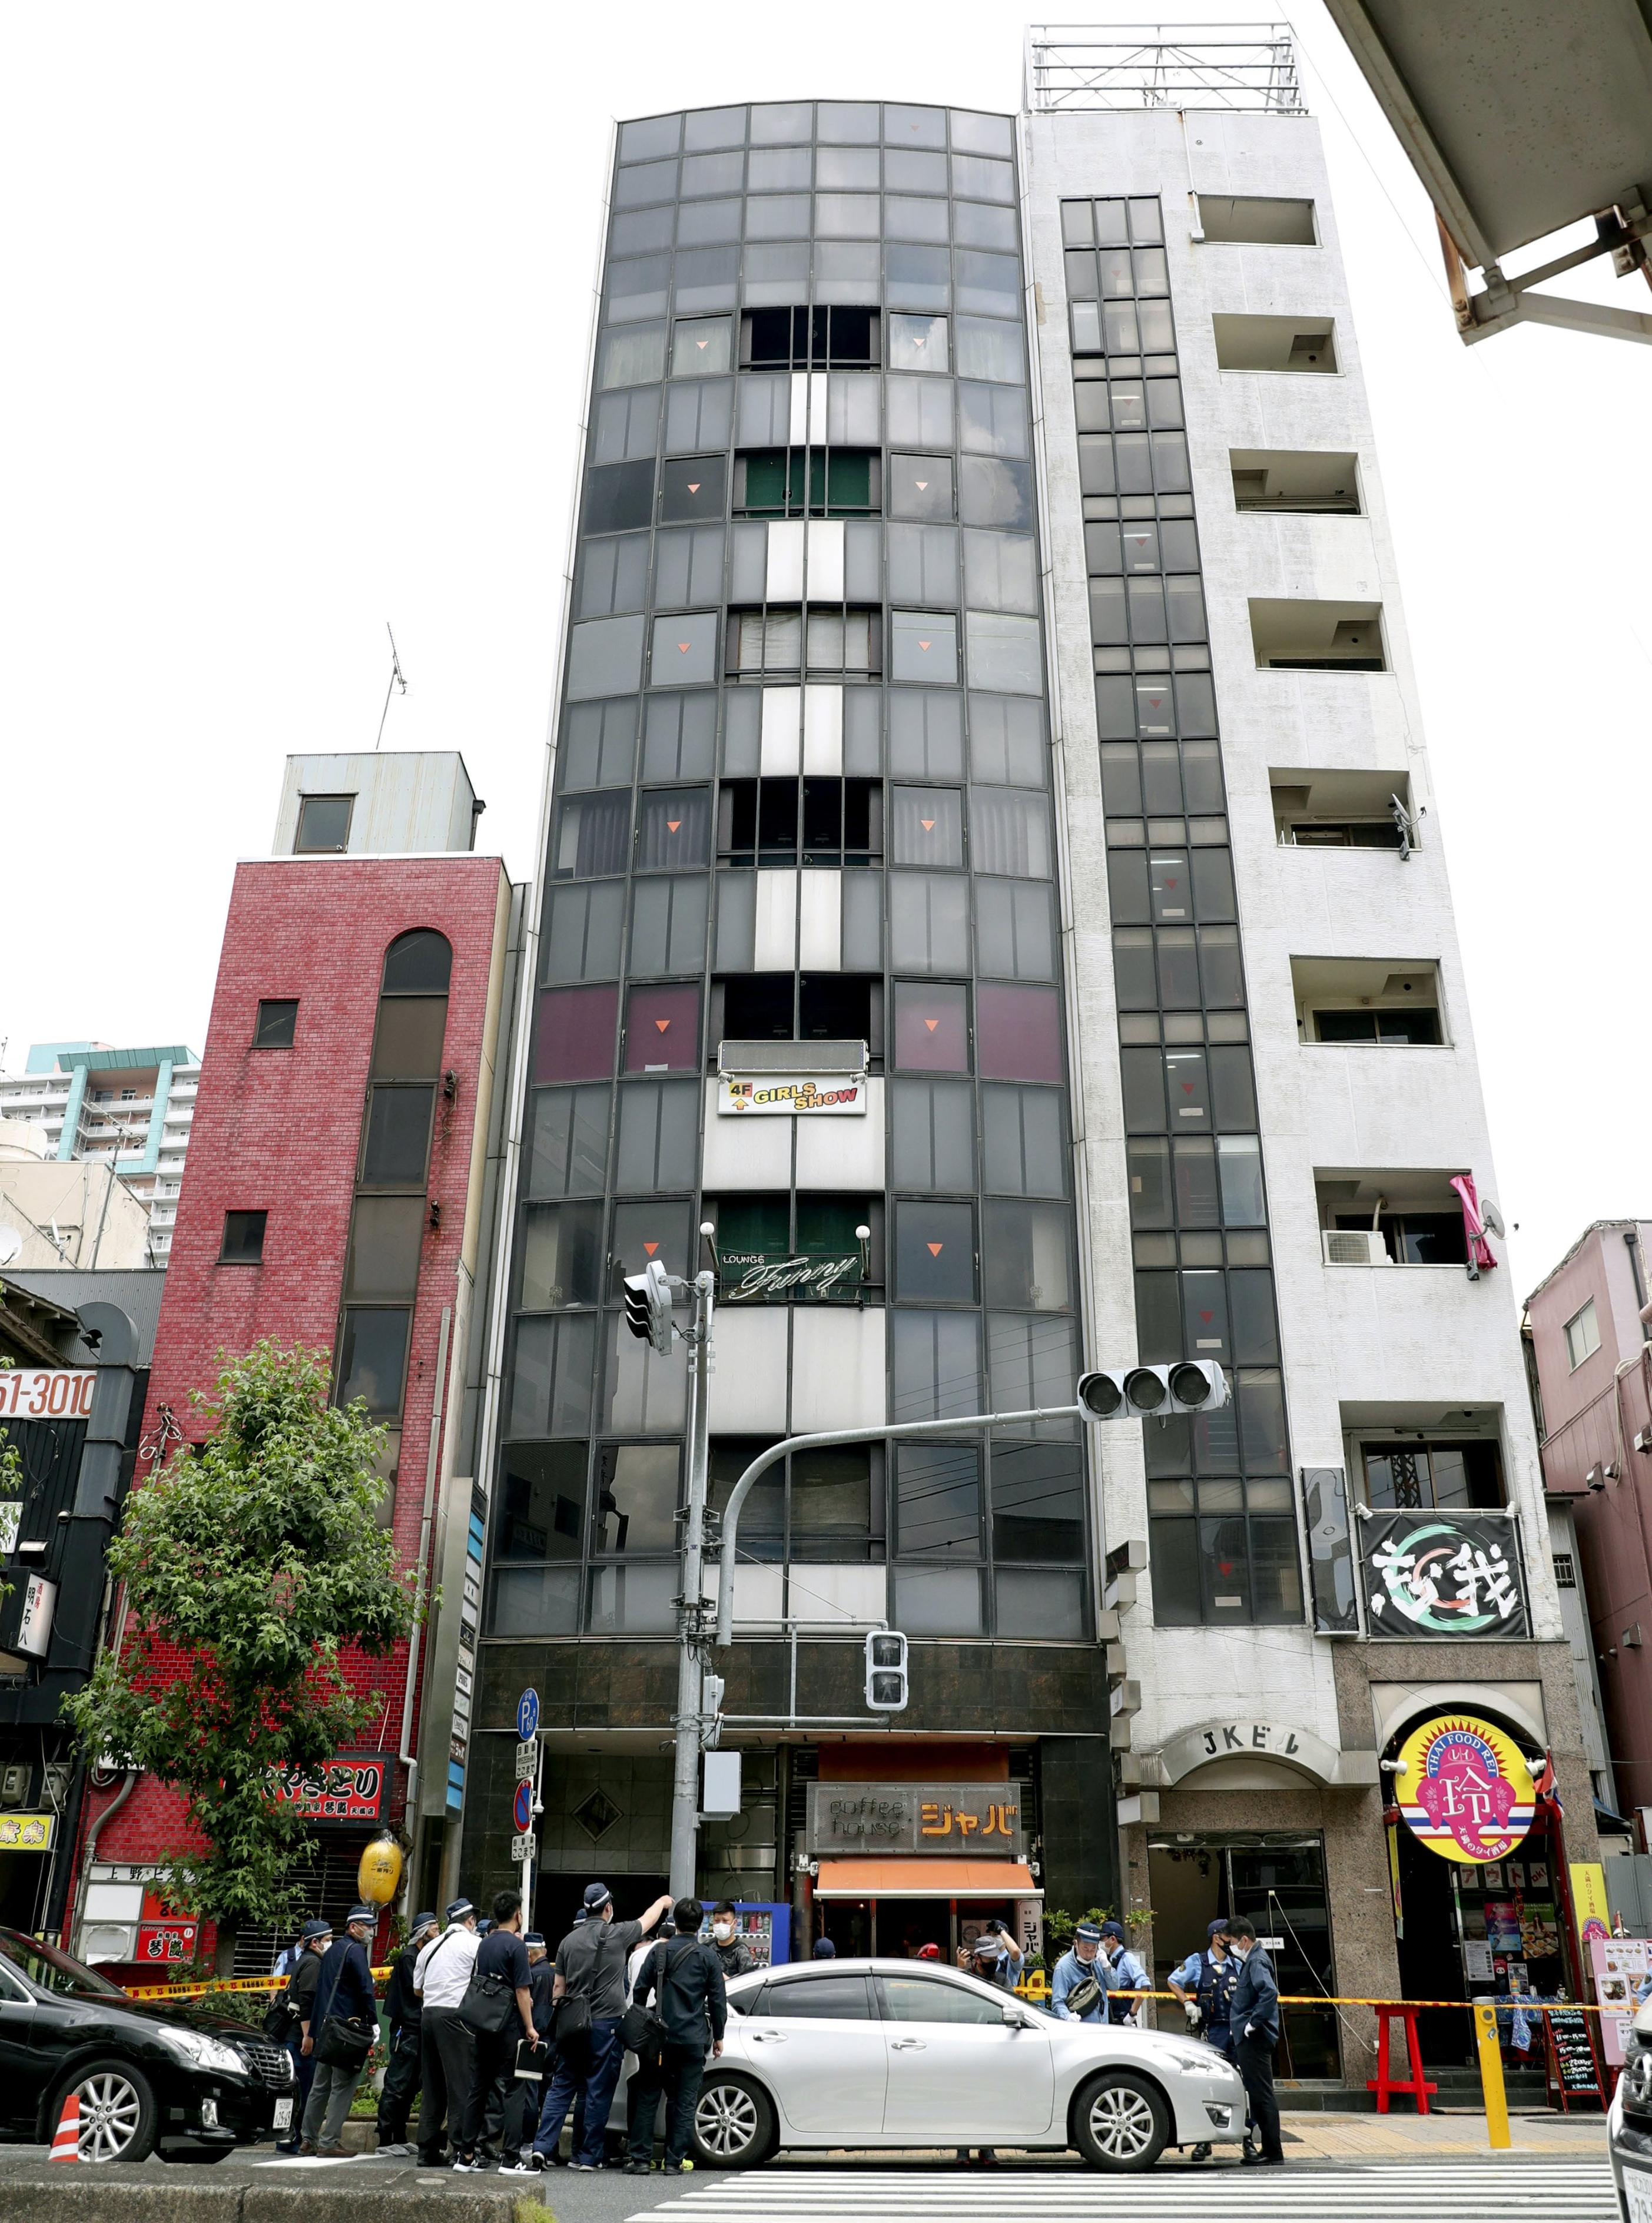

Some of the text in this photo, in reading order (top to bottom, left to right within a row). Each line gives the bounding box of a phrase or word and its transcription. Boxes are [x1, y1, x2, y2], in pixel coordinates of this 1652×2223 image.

[731, 1084, 752, 1095] 4F
[754, 1082, 816, 1104] GIRLS
[794, 1088, 857, 1110] SHOW
[723, 1255, 765, 1264] LOUNGE
[728, 1257, 857, 1299] Funny
[19, 1587, 35, 1645] 明石八
[522, 1701, 530, 1733] P
[1430, 1734, 1497, 1773] THAI FOOD REI
[517, 1764, 535, 1776] ここまで
[830, 1797, 904, 1815] coffee
[833, 1819, 901, 1836] house
[920, 1803, 1018, 1836] ジャバ
[512, 1846, 534, 1859] ここまで
[1024, 1922, 1039, 1953] ジャバ
